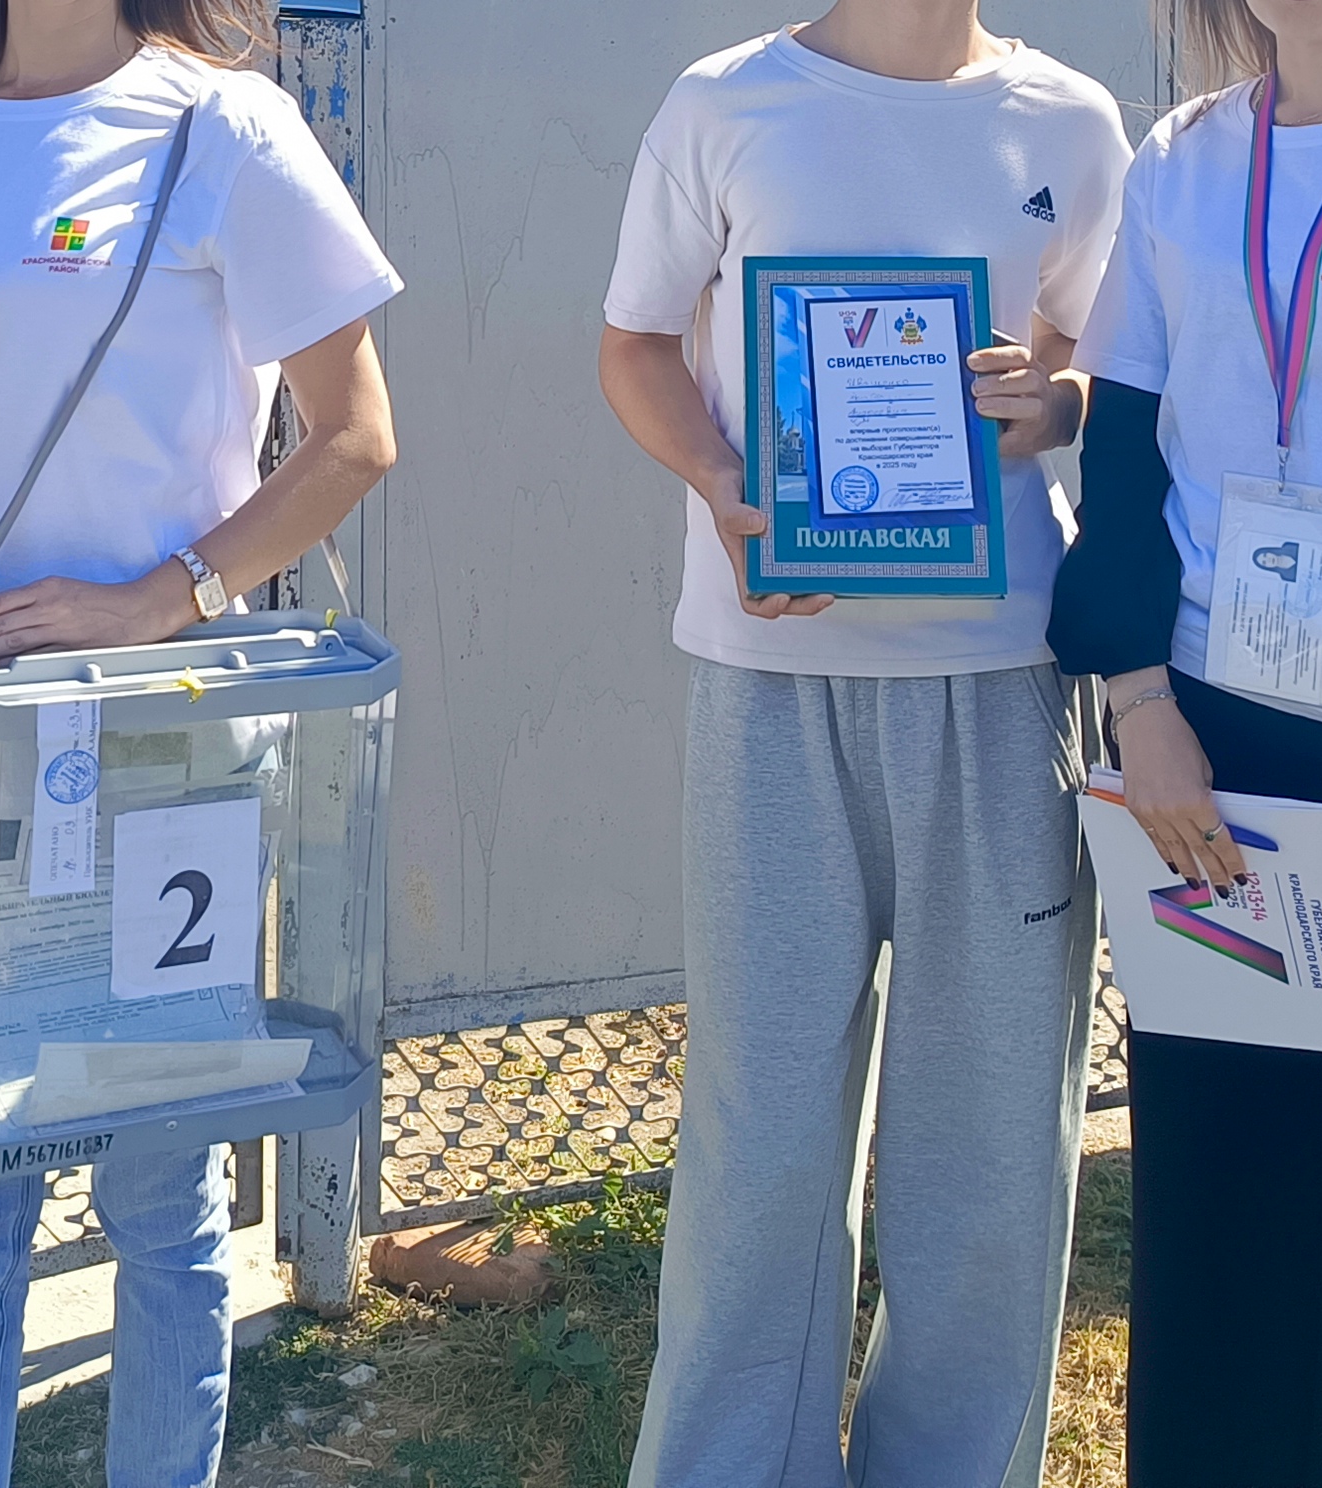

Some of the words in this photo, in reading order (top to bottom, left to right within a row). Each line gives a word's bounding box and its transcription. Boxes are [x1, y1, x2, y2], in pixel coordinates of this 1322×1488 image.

[22, 256, 111, 267] КРАСНОАРМЕЙСКИЙ
[49, 264, 79, 274] РАЙОН
[827, 353, 947, 369] СВИДЕТЕЛЬСТВО
[861, 443, 892, 452] выборах
[893, 442, 940, 452] Губернатора
[858, 453, 915, 461] Краснодарского
[882, 461, 900, 469] 2025
[796, 527, 951, 548] ПОЛТАВСКАЯ
[155, 869, 216, 969] 2
[1288, 873, 1318, 962] КРАСНОДАРСКОГО
